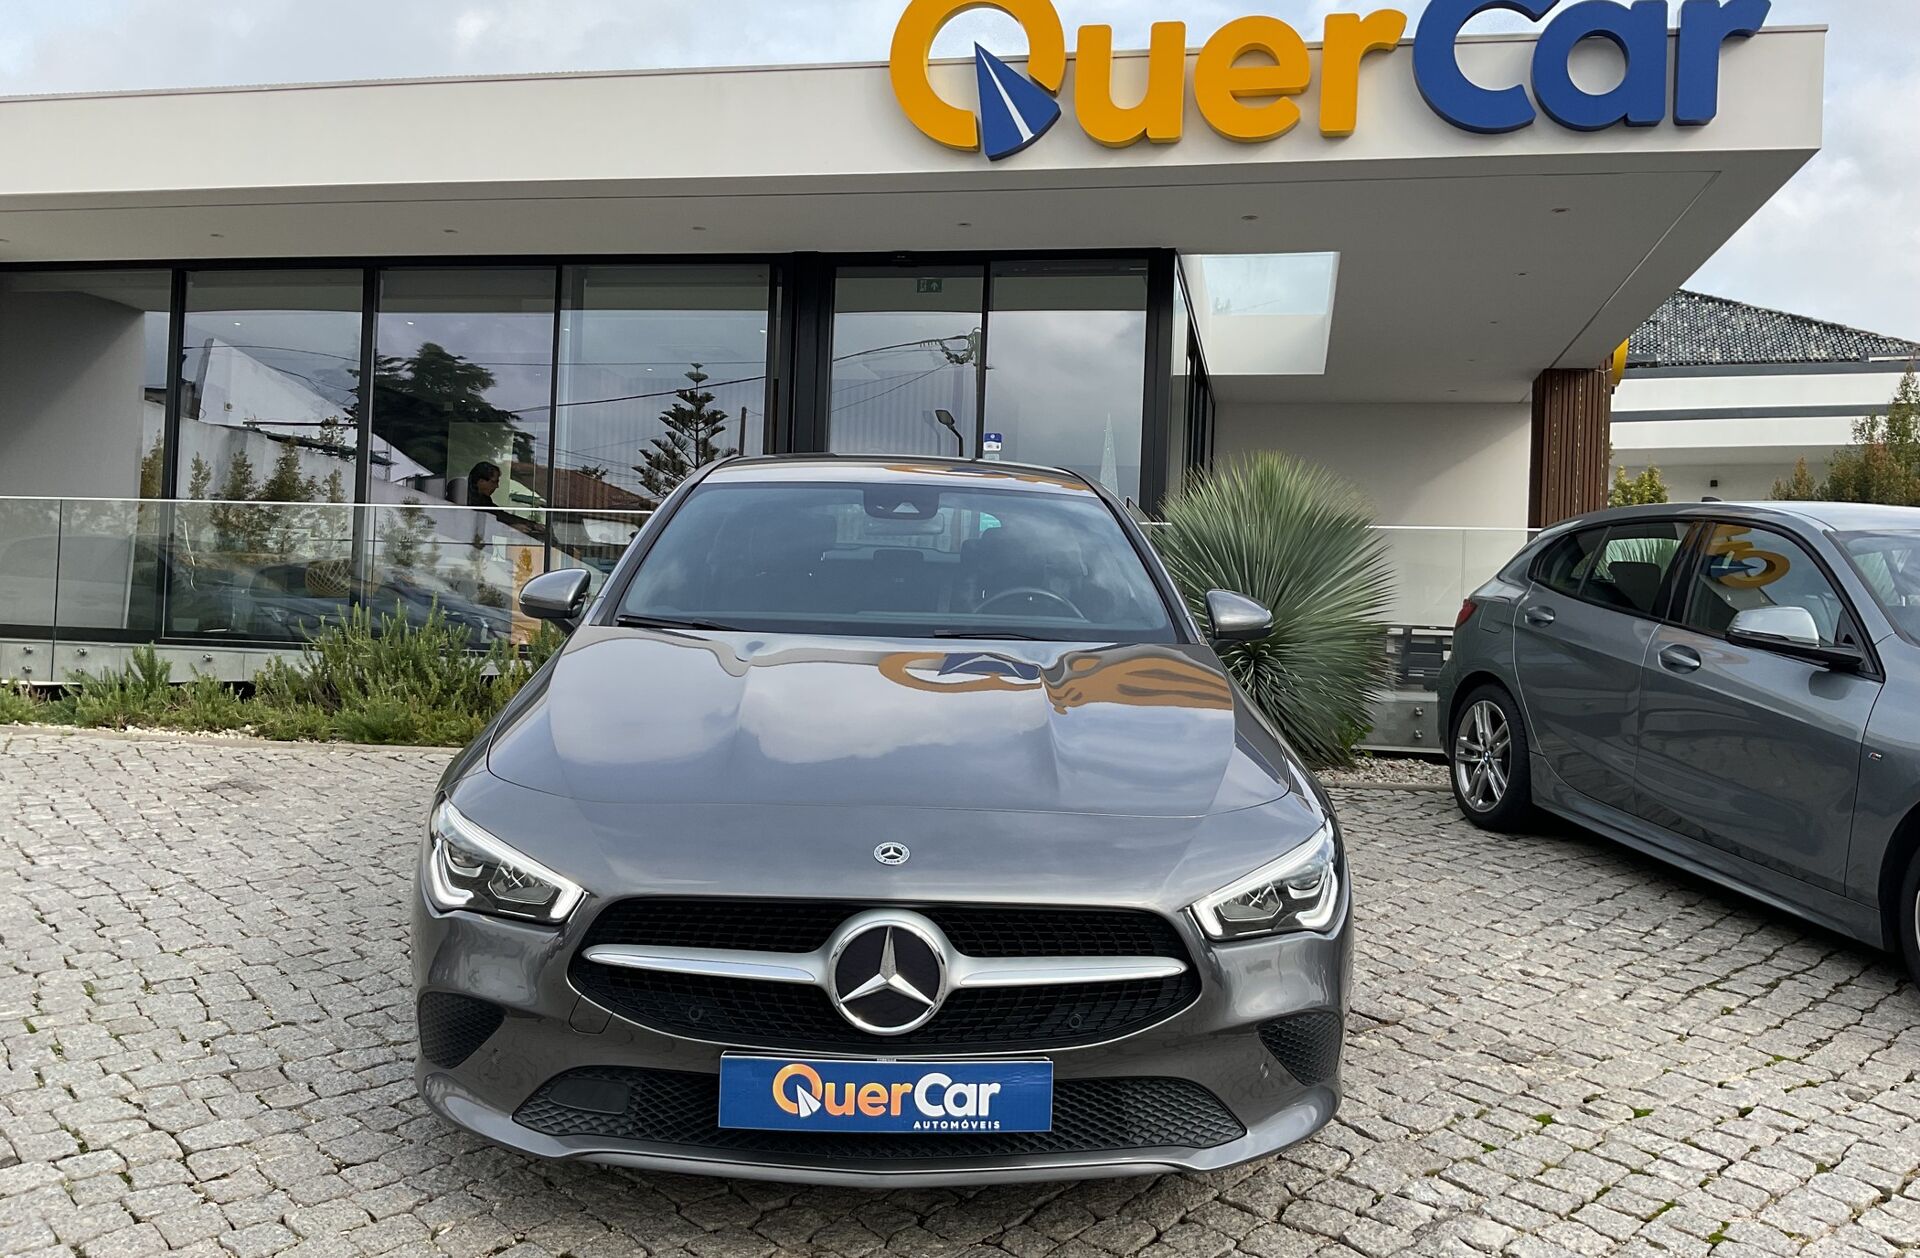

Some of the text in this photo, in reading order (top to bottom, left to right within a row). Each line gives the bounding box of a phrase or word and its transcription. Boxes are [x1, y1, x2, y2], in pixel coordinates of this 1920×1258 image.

[889, 0, 1771, 160] QuerCar
[772, 1063, 1001, 1117] QuerCar
[913, 1119, 1000, 1130] AUTOMÓVEIS
